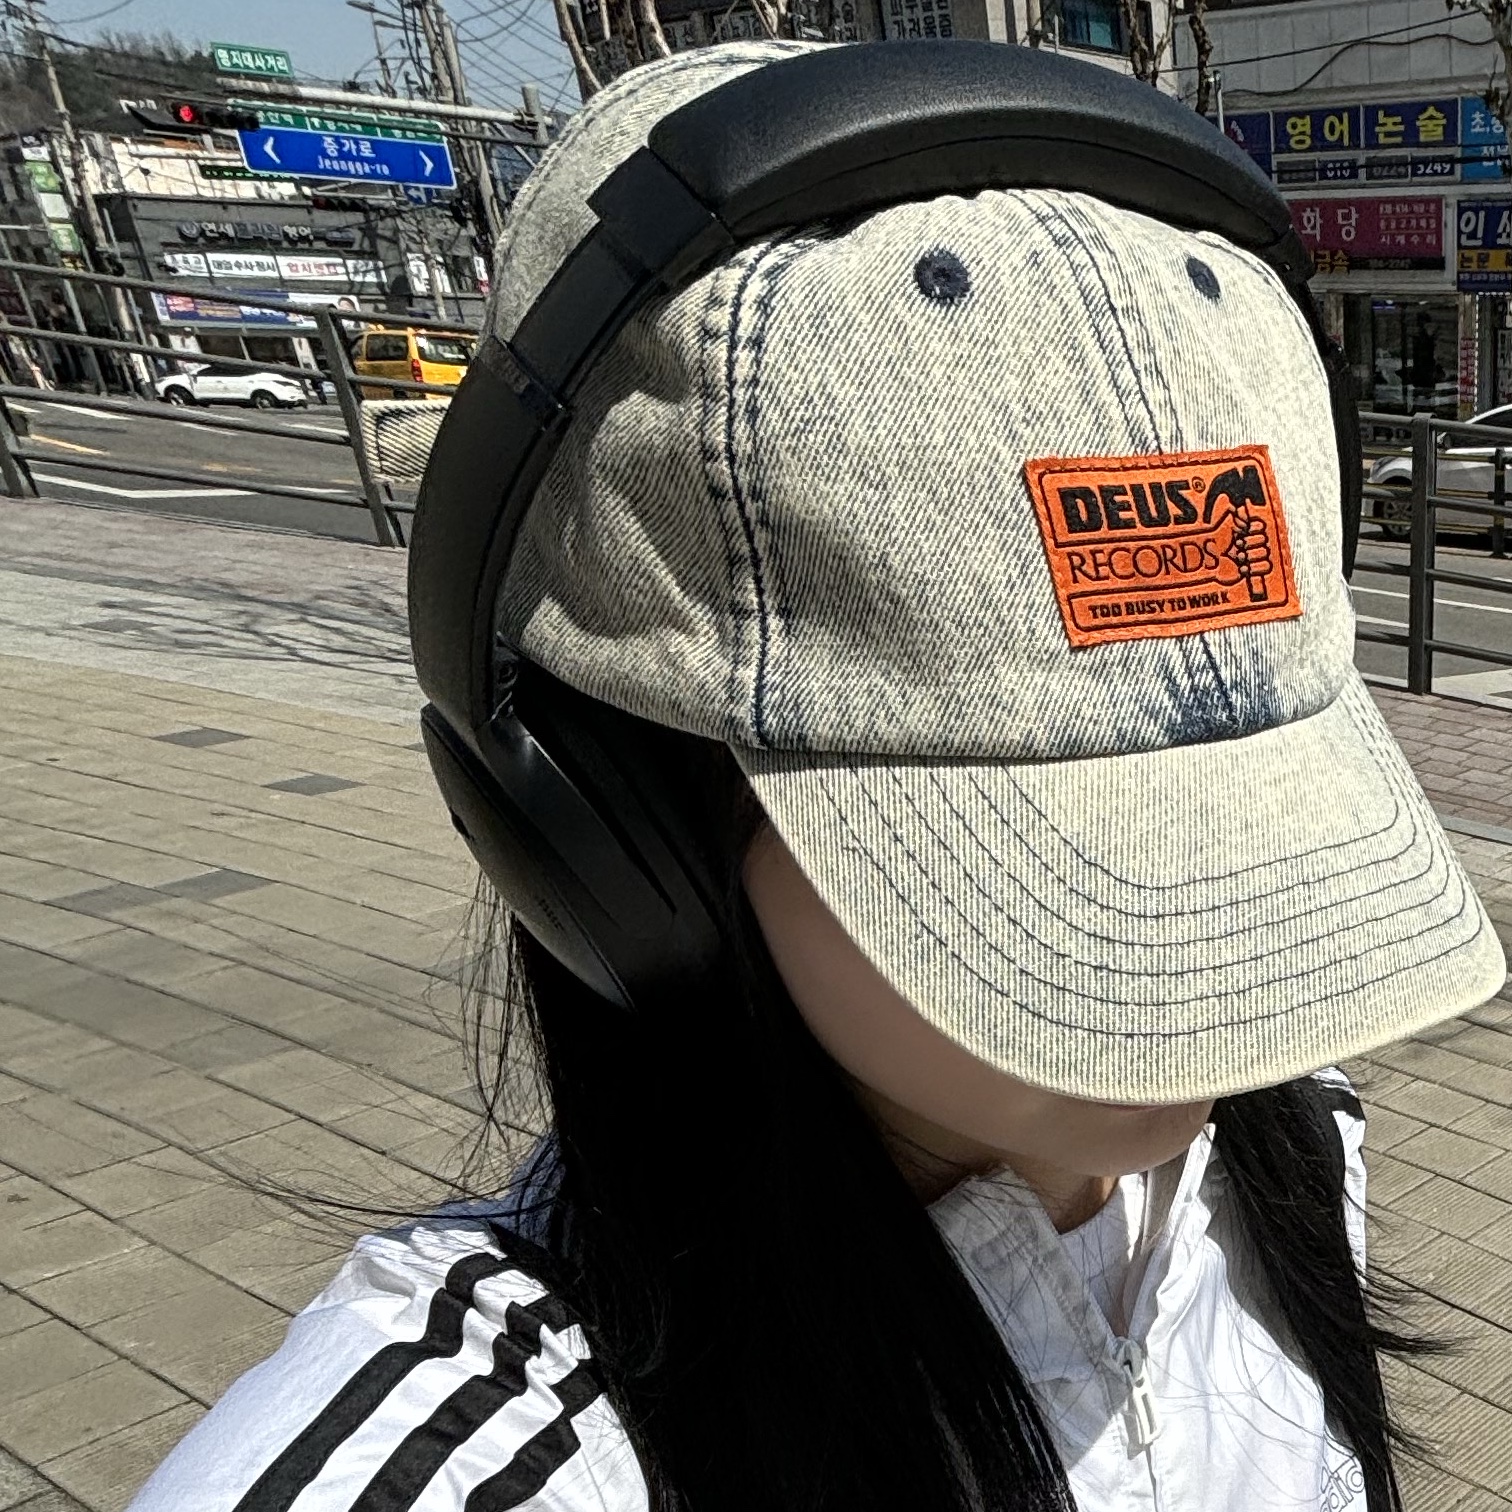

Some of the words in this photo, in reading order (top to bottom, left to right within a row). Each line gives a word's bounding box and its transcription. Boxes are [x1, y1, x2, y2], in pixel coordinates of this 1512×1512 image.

[322, 136, 377, 158] 증가로
[1285, 110, 1351, 150] 영어
[1374, 104, 1448, 145] 논술
[1056, 479, 1198, 535] DEUS
[1066, 538, 1220, 584] RECORDS
[1088, 601, 1121, 620] TOO
[1125, 599, 1165, 617] BUSY
[1168, 597, 1187, 613] TO
[1189, 591, 1231, 610] WORK
